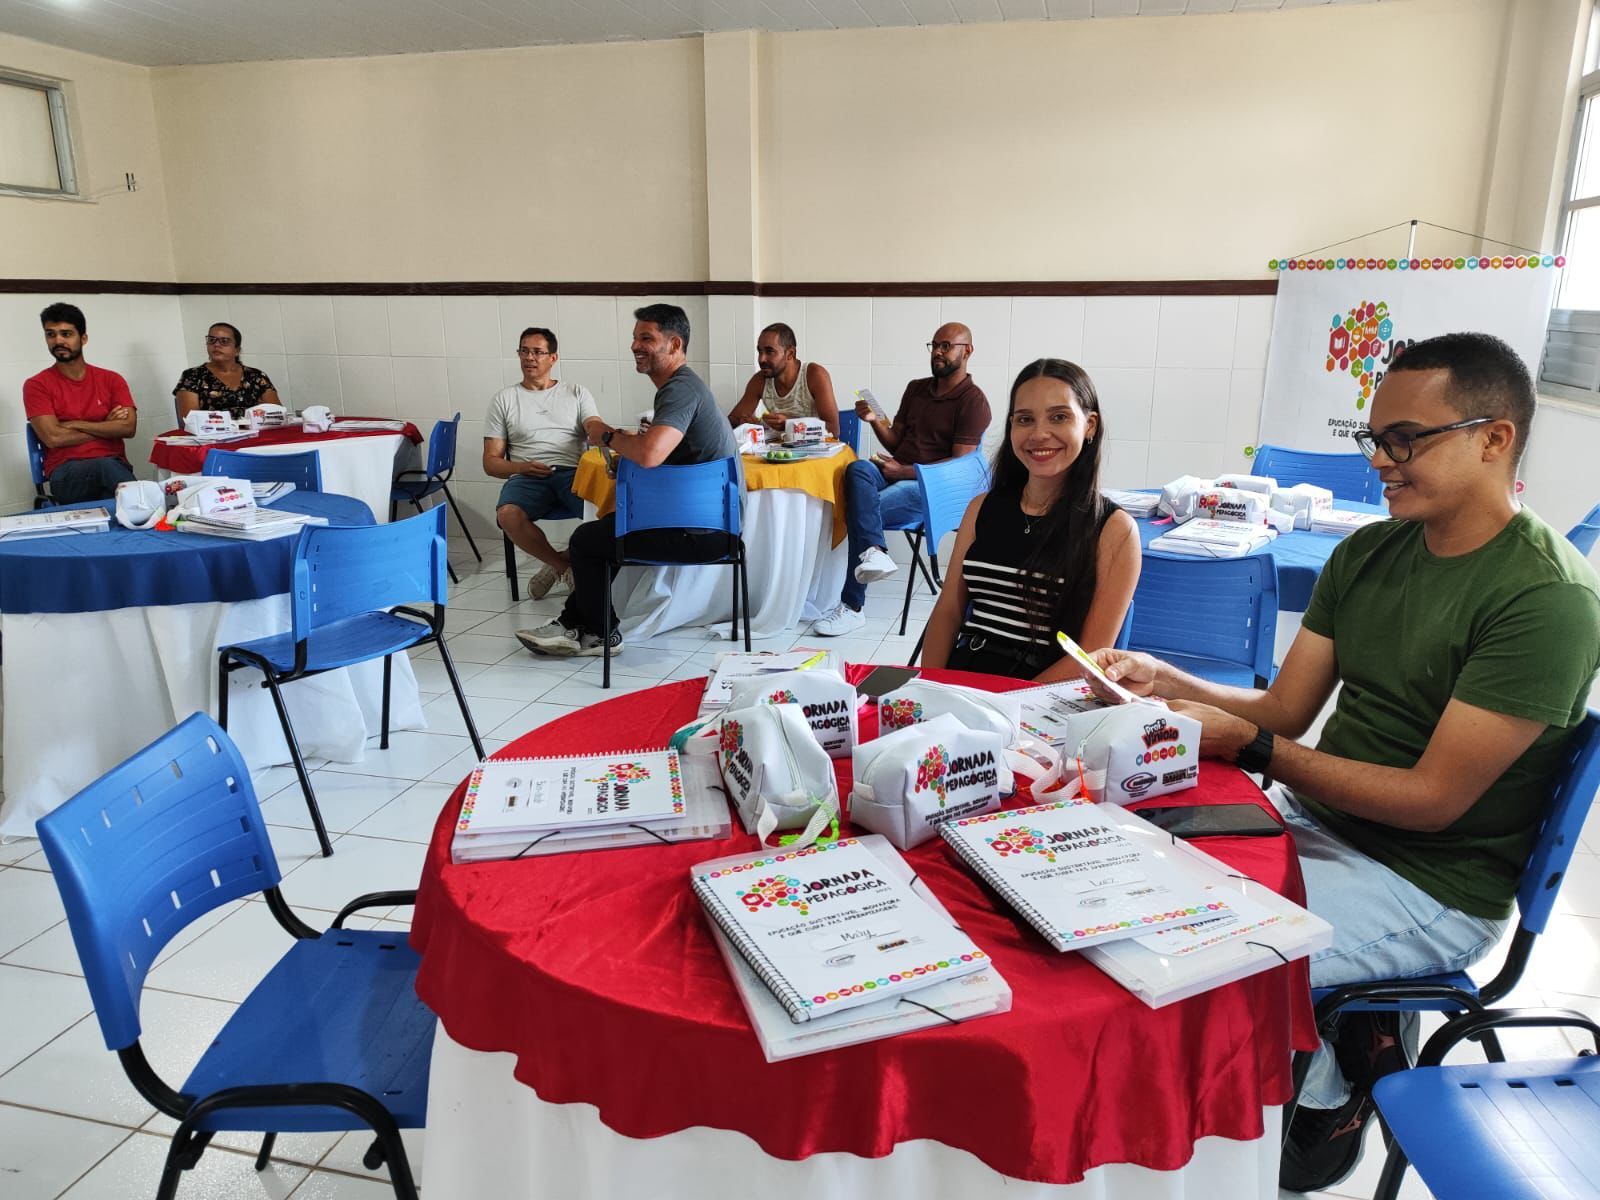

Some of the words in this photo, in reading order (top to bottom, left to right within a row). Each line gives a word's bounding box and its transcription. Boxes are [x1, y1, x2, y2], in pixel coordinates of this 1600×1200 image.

[802, 699, 849, 718] ORNADA
[808, 715, 850, 731] AGÓGICA
[946, 750, 995, 777] JORNADA
[945, 768, 997, 793] PEDAGÓGICA
[1046, 825, 1113, 845] JORNADA
[802, 868, 874, 894] JORNADA
